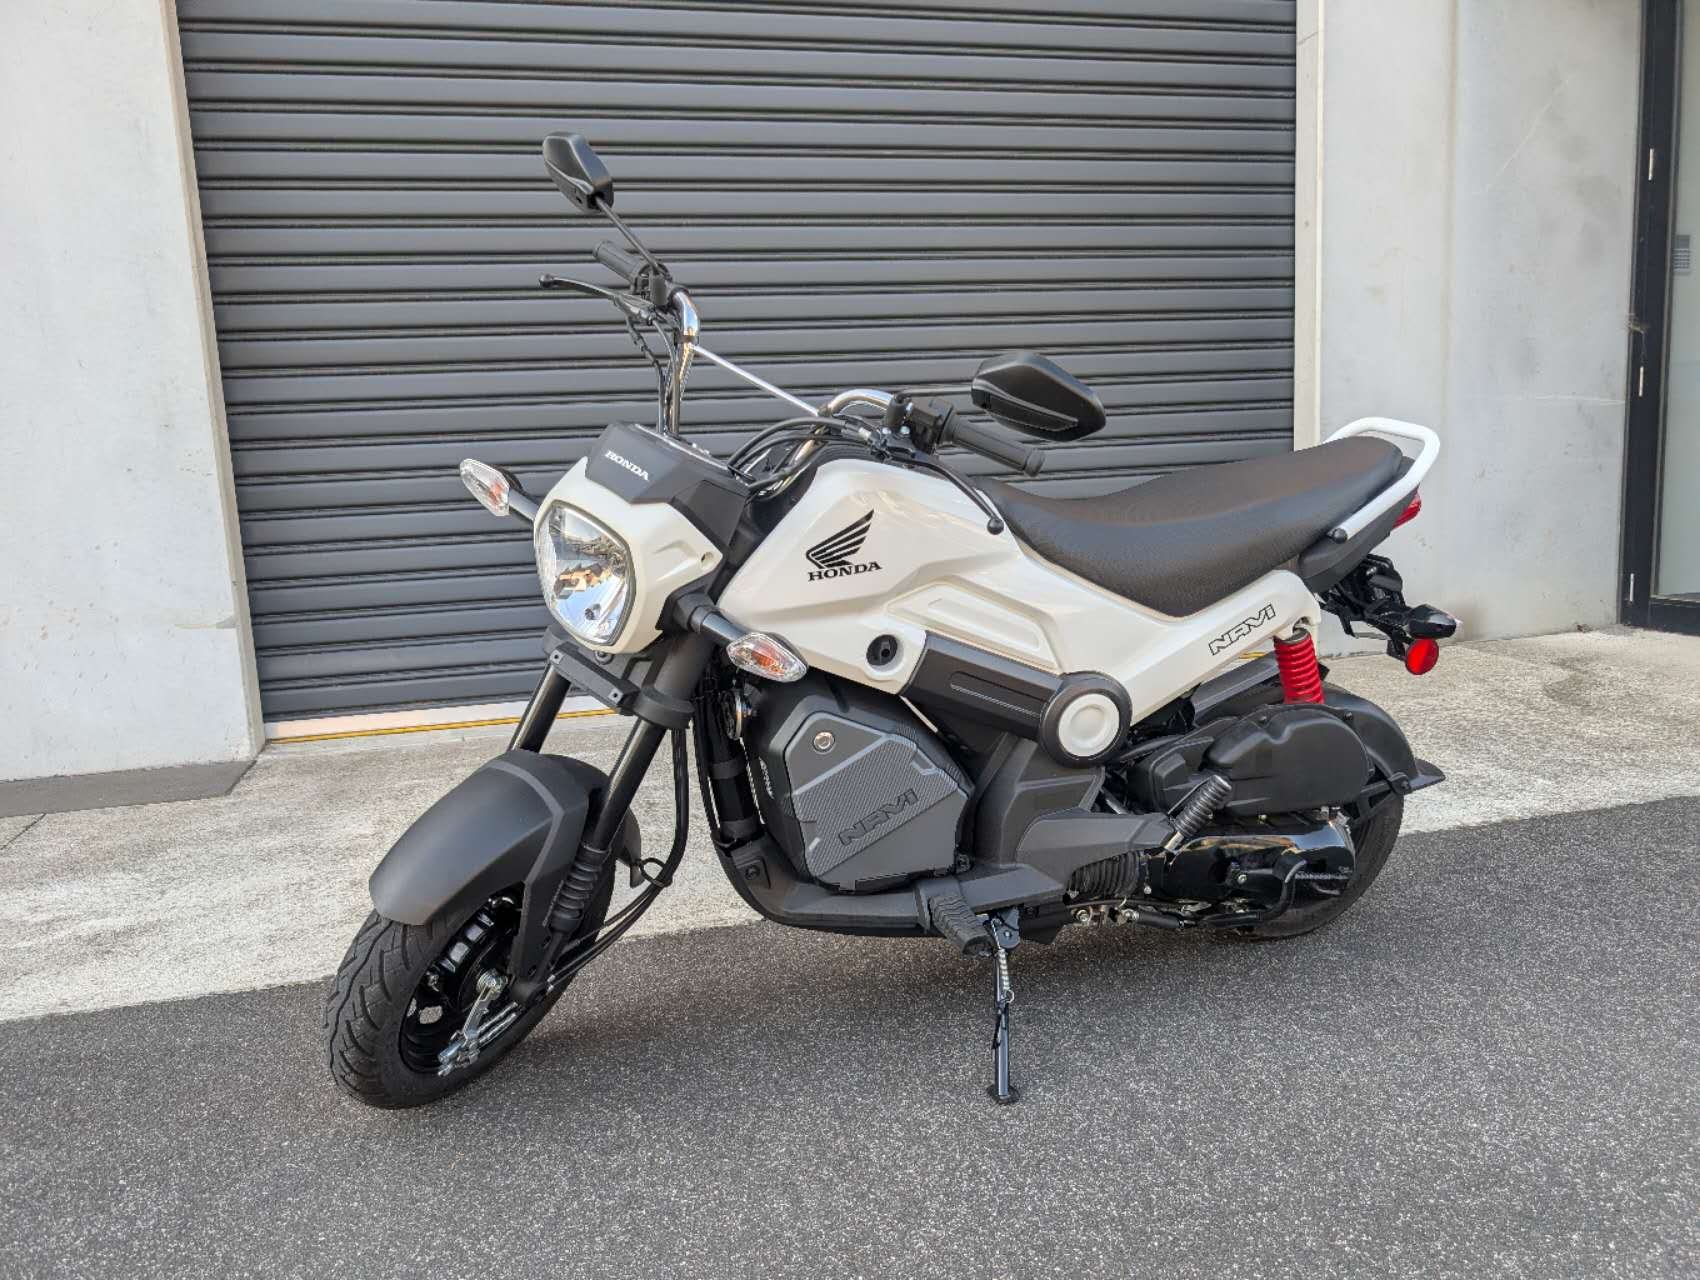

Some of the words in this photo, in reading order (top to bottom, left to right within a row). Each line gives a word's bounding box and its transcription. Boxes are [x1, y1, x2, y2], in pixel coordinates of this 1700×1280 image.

[604, 450, 649, 481] HONDA
[807, 561, 882, 582] HONDA
[1208, 604, 1276, 656] NAVI
[838, 788, 919, 846] NAVI
